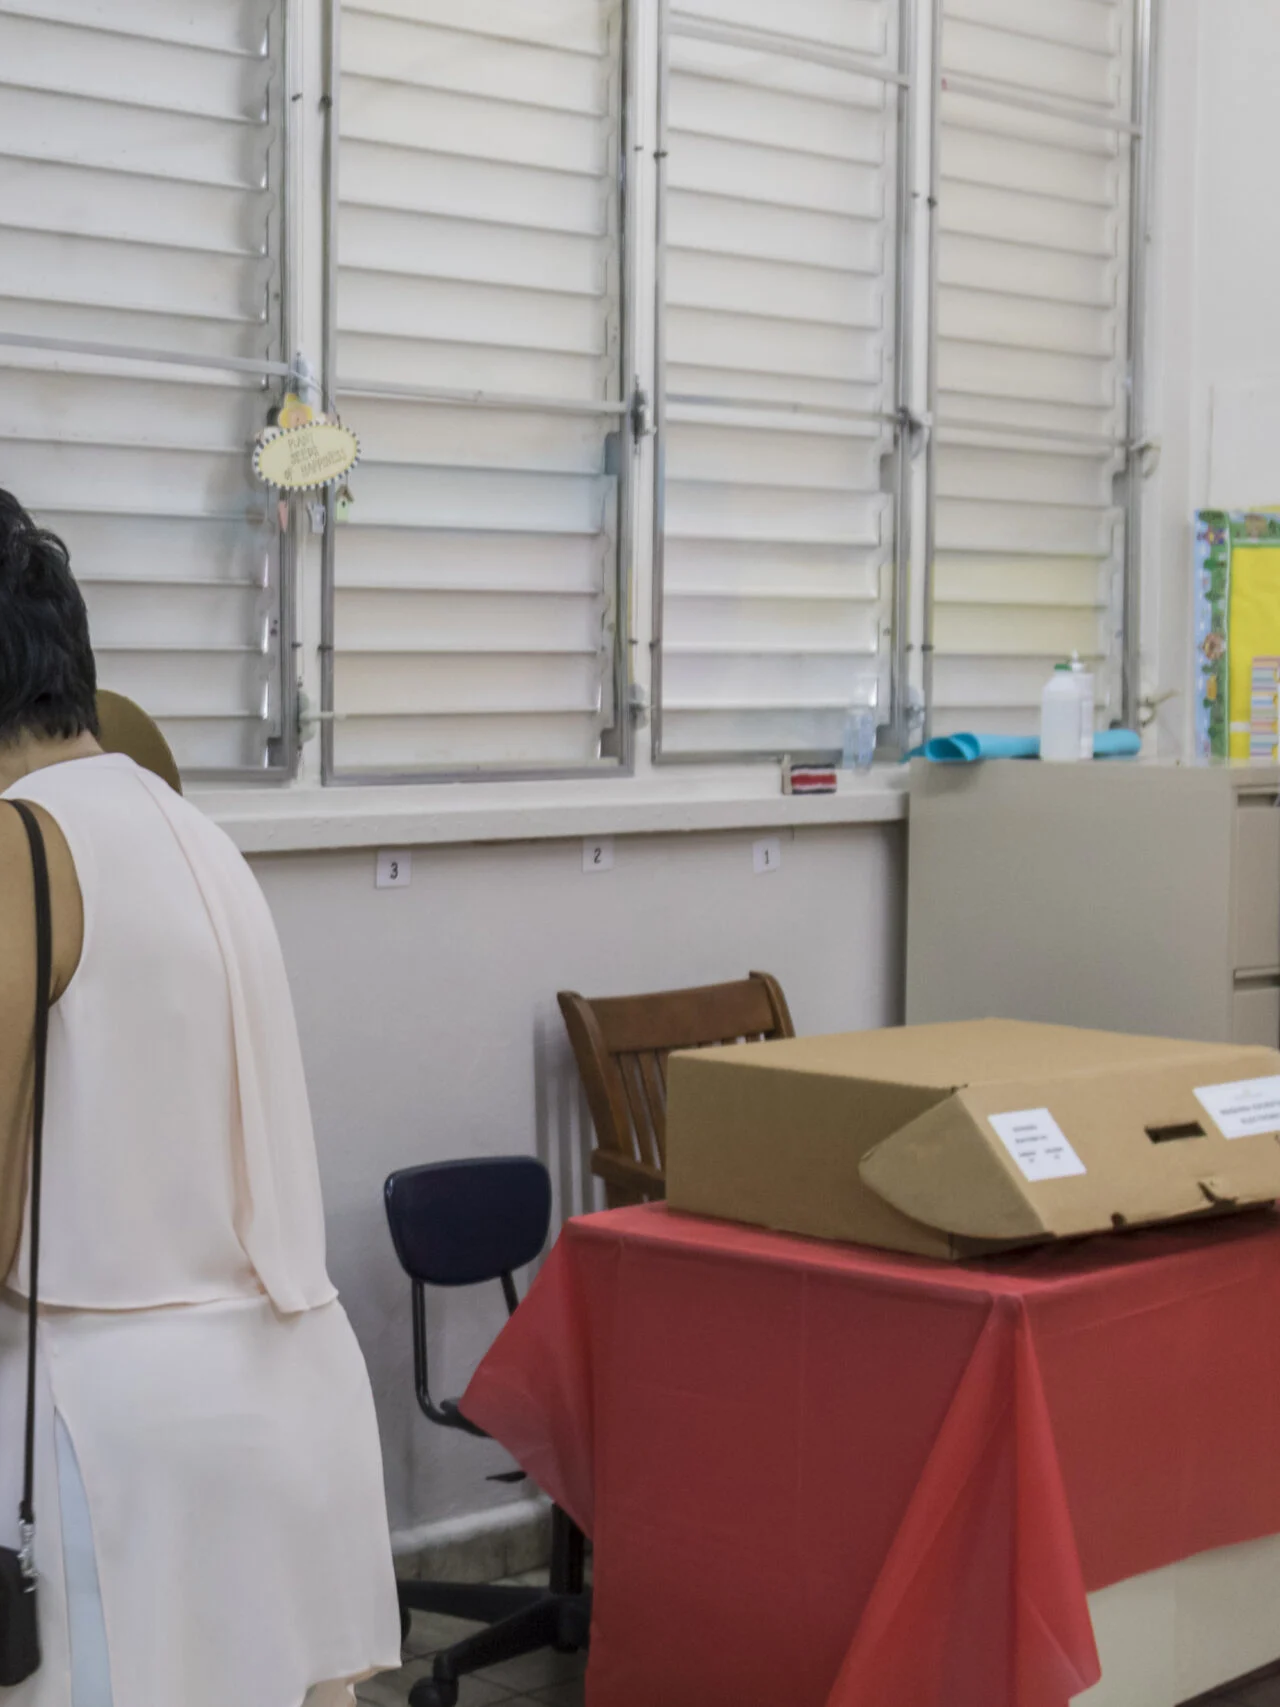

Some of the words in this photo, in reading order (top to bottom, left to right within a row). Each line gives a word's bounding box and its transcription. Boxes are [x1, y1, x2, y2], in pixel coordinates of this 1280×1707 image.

[593, 848, 602, 864] 2
[764, 849, 770, 865] 1
[389, 862, 400, 880] 3
